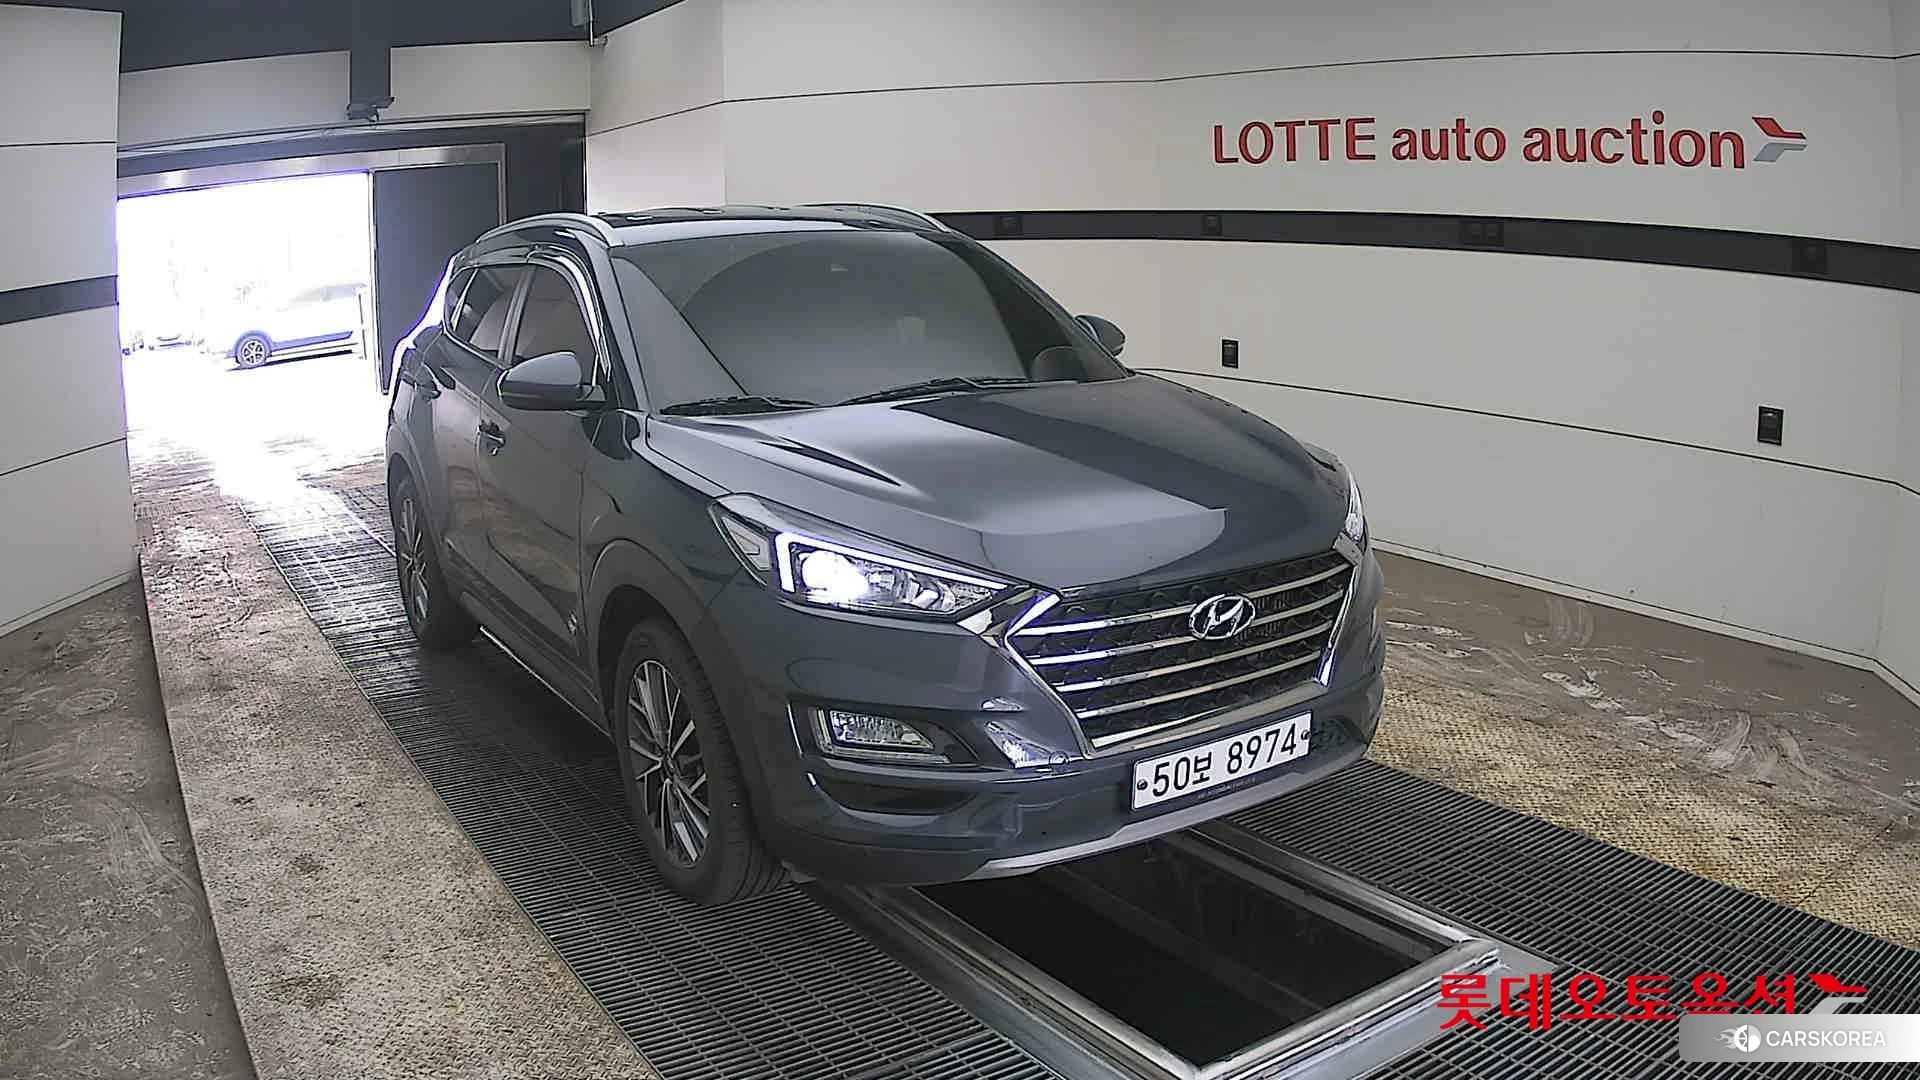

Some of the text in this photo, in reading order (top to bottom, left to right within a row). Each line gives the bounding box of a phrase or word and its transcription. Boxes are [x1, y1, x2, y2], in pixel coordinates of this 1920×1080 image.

[1213, 110, 1745, 169] LOTTE auto auction
[1152, 752, 1212, 797] 50보
[1227, 723, 1297, 774] 8974
